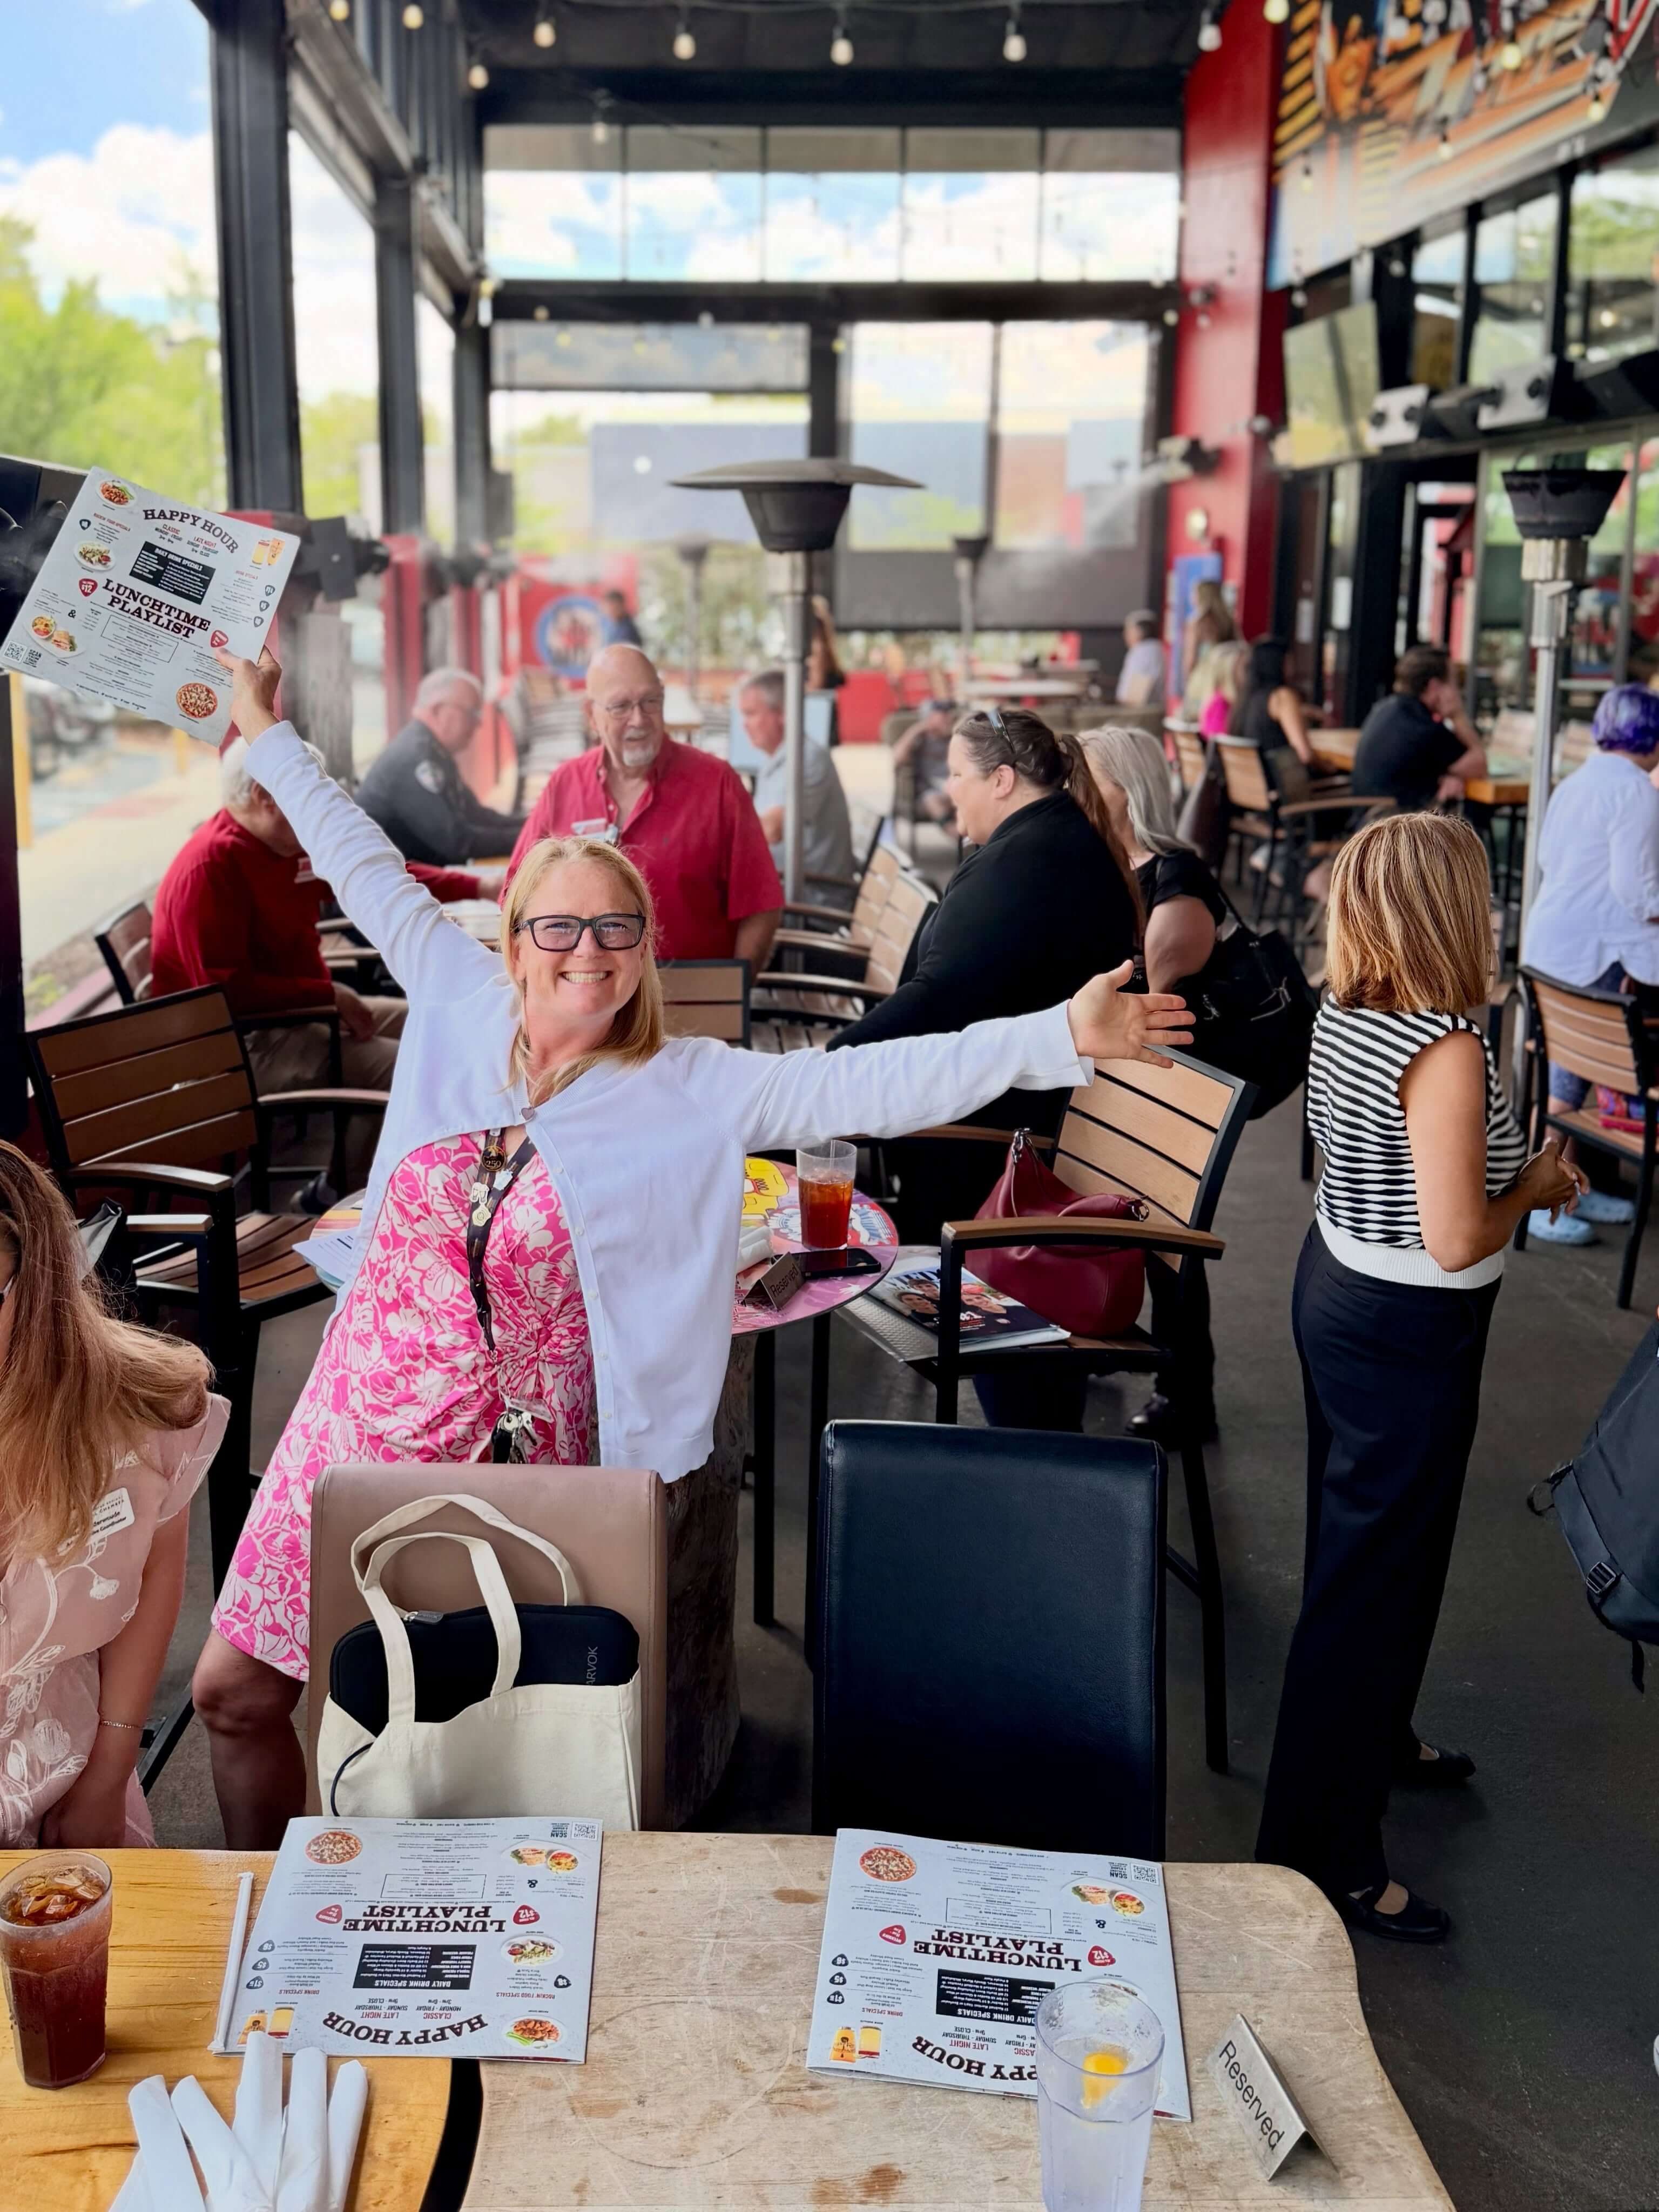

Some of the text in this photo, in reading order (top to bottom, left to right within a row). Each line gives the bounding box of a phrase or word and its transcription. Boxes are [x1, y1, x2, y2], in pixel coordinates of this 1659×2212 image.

[143, 509, 202, 526] HAPPY
[200, 519, 239, 554] HOUR
[102, 578, 211, 631] LUNCHTIME
[68, 609, 76, 619] &
[107, 595, 195, 638] PLAYLIST
[770, 1263, 799, 1297] Reserved
[527, 1879, 538, 1889] &
[363, 1905, 493, 1918] PLAYLIST
[518, 1908, 535, 1918] $12
[342, 1919, 506, 1932] LUNCHTIME
[1095, 1919, 1107, 1928] &
[931, 1928, 1064, 1955] PLAYLIST
[913, 1940, 1082, 1972] LUNCHTIME
[1091, 1950, 1109, 1960] $12
[957, 2009, 991, 2019] SPECIALS
[993, 2013, 1015, 2021] DRINK
[322, 2012, 488, 2046] HAPPY HOUR
[942, 2032, 970, 2040] THURSDAY
[975, 2035, 997, 2044] SUNDAY
[949, 2040, 989, 2051] LATE NIGHT
[1014, 2047, 1035, 2057] ASSIC
[912, 2036, 1037, 2081] PPY HOUR
[1219, 2040, 1285, 2151] Reserved
